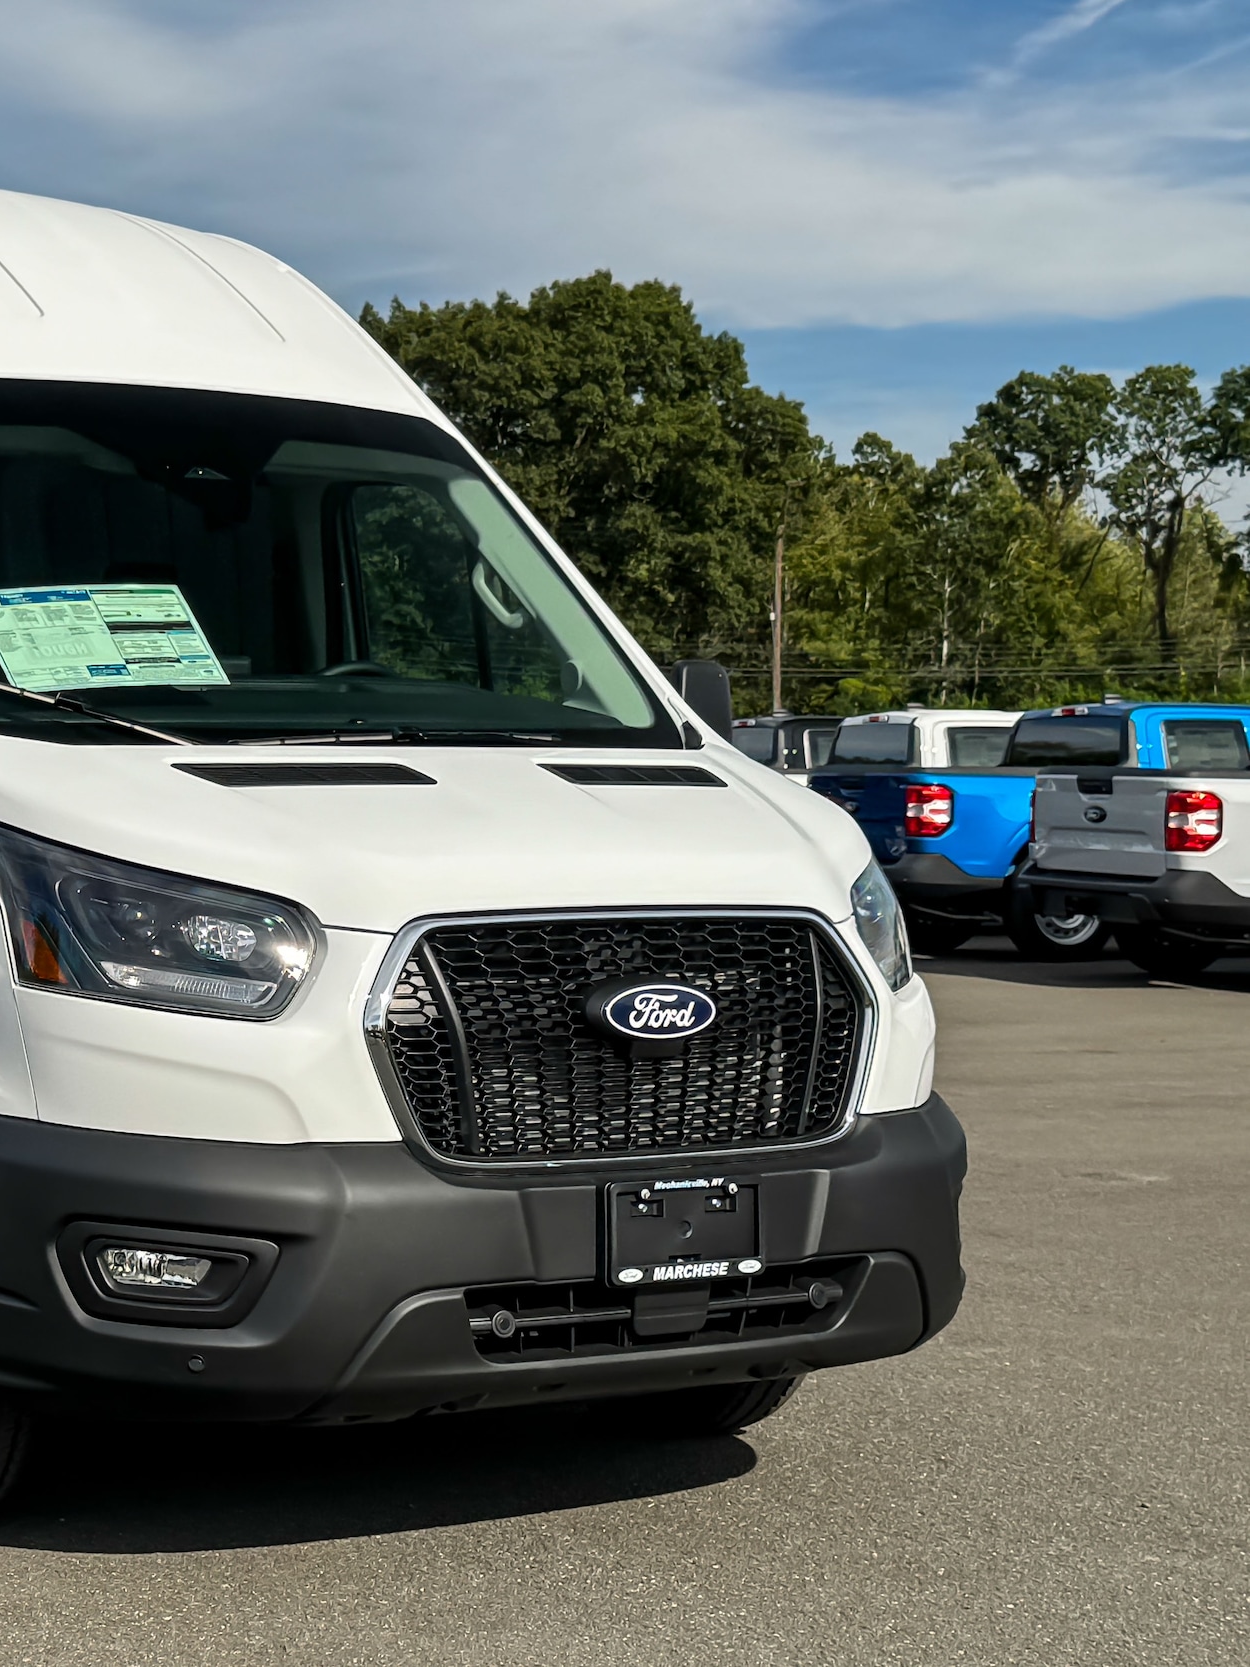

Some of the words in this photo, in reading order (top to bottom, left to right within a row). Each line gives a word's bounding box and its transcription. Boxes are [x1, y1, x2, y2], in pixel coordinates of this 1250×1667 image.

[629, 993, 695, 1028] Ford
[711, 1178, 725, 1187] NY
[653, 1262, 729, 1281] MARCHESE
